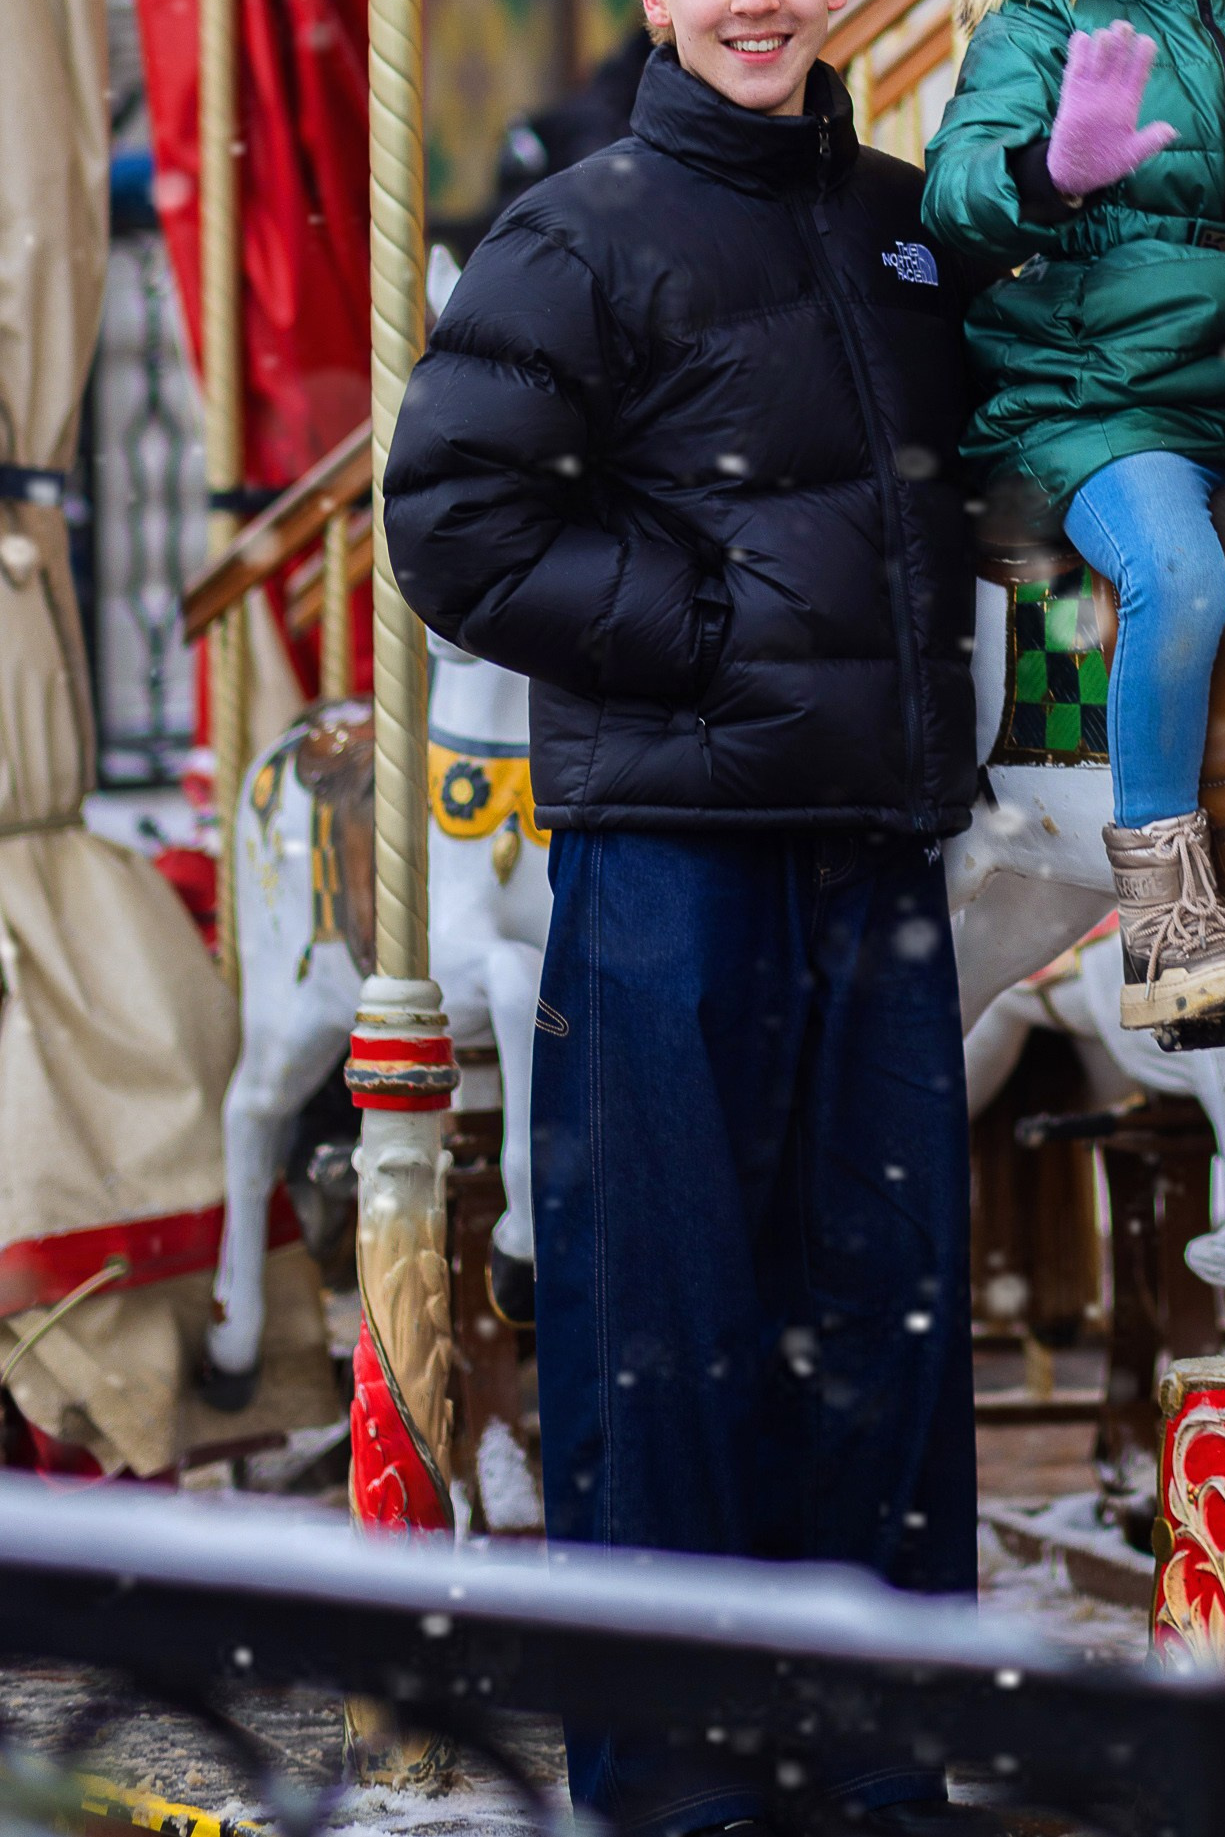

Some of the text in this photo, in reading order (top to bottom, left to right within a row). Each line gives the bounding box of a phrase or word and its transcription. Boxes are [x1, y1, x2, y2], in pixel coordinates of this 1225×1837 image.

[895, 241, 919, 256] THE
[881, 252, 919, 269] NORTH
[897, 269, 923, 283] FACE
